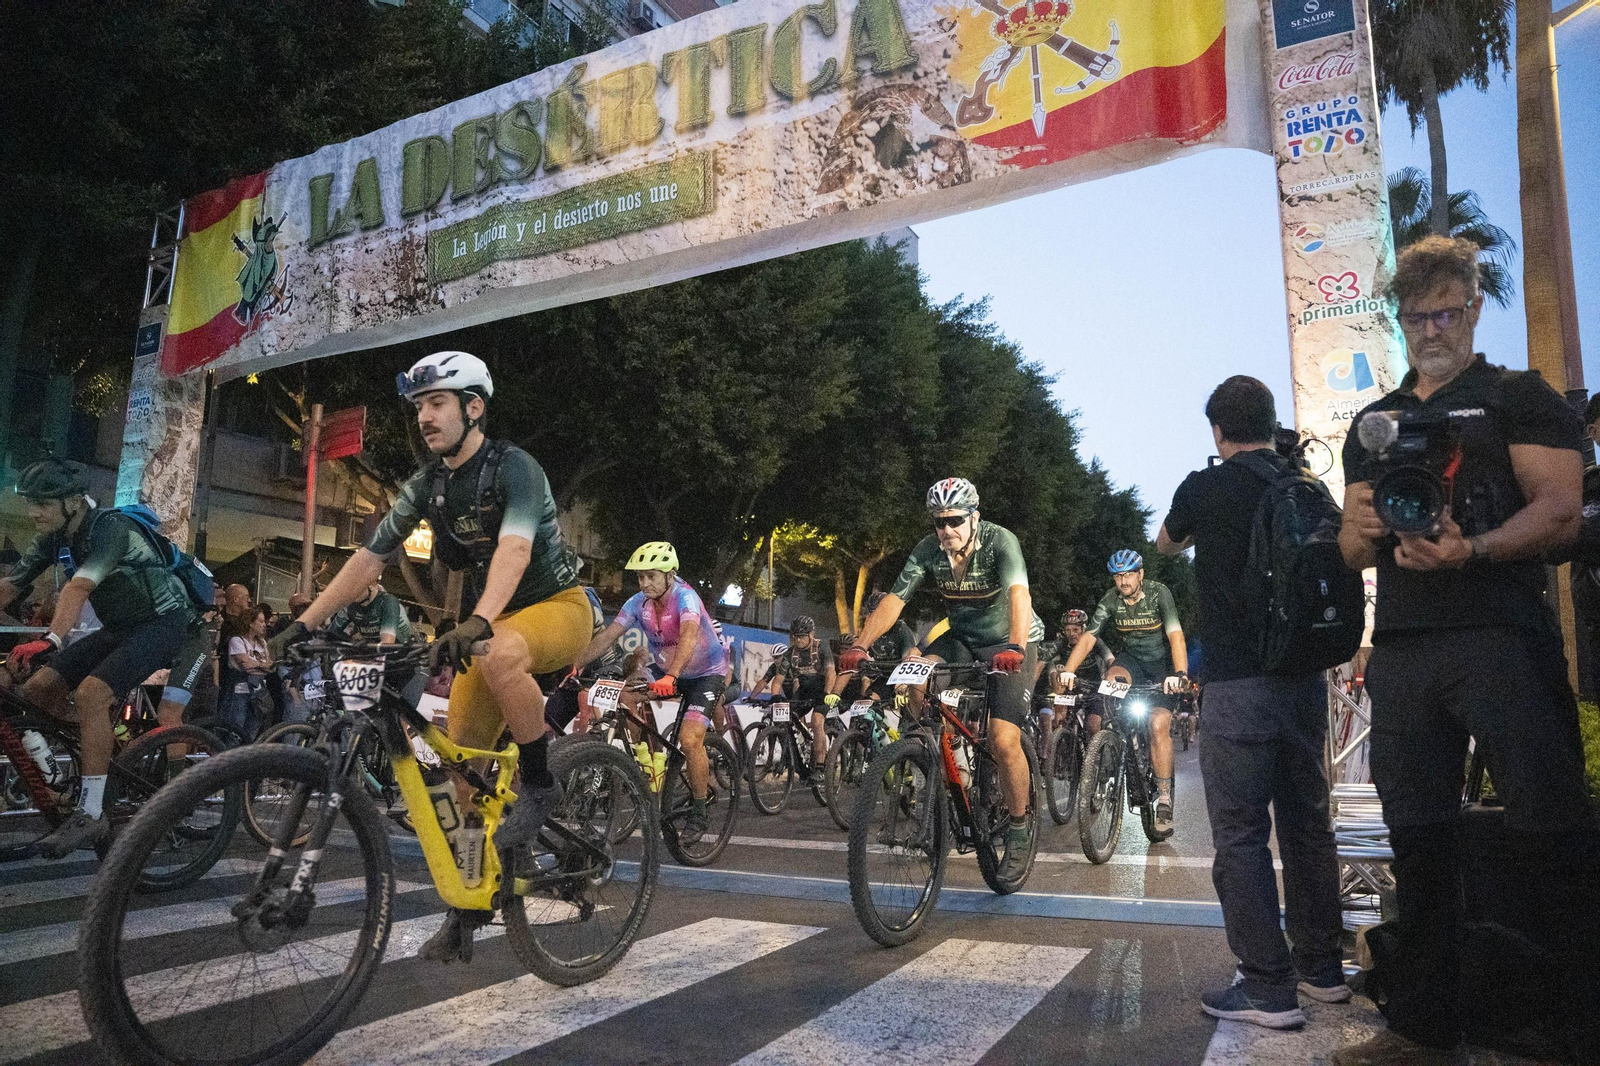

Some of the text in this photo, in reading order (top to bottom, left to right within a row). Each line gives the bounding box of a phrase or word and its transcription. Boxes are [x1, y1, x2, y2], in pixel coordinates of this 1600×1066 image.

[1290, 10, 1336, 28] SENATOR
[1278, 51, 1359, 90] Coca-Cola
[1286, 96, 1359, 119] GRUPO
[307, 0, 920, 249] LA DESÉRTICA
[1287, 108, 1363, 138] RENTA
[1288, 127, 1365, 158] TODO
[452, 182, 679, 259] La Legión y el desierto nos une
[1302, 300, 1386, 326] primaflor
[182, 653, 207, 689] STONEBIKERS
[340, 666, 380, 692] 6369
[898, 663, 931, 676] 5526
[595, 686, 621, 701] 6858
[467, 841, 477, 880] MAURTEN
